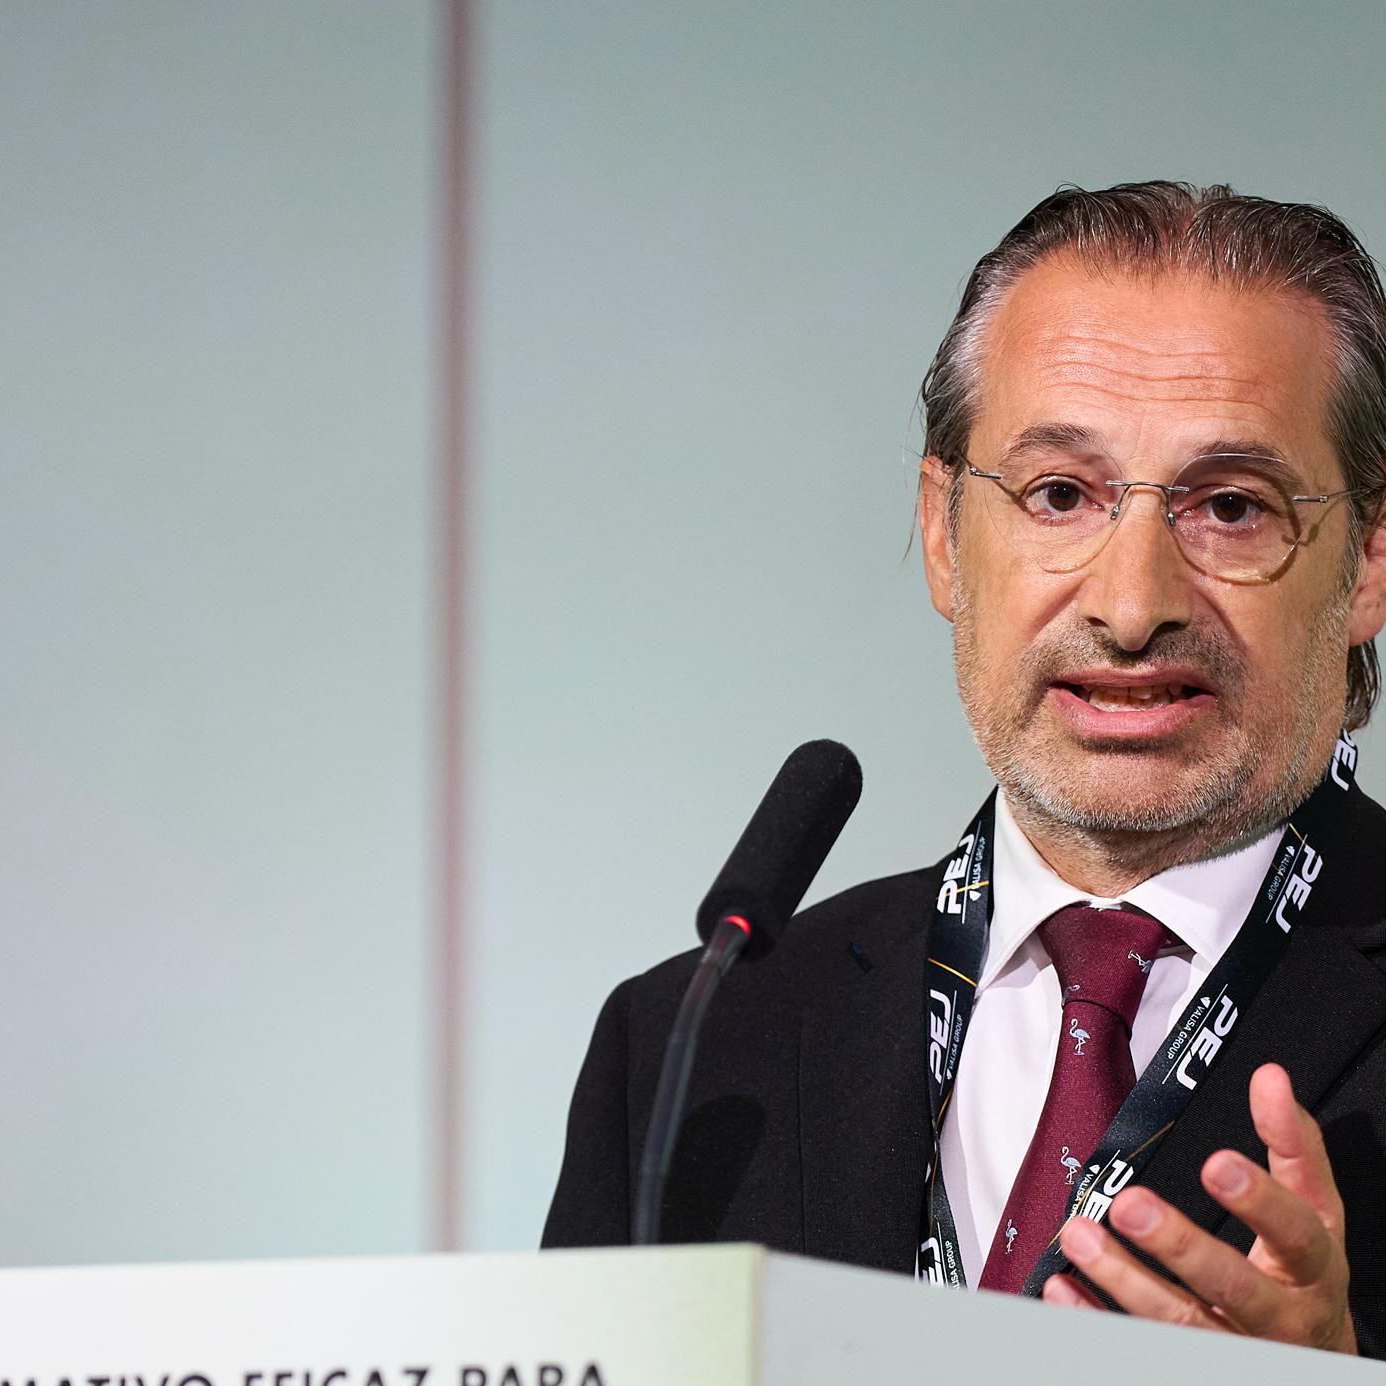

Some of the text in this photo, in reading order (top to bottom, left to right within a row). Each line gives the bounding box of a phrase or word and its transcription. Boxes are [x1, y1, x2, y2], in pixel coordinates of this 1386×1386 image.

[936, 833, 974, 914] PEJ
[1266, 875, 1282, 901] GROUP
[1275, 843, 1323, 933] PEJ
[929, 988, 951, 1085] PEJ
[954, 1014, 964, 1043] GROUP
[1166, 1005, 1206, 1060] VALISA GROUP
[1176, 995, 1239, 1091] PEJ
[1074, 1173, 1094, 1202] VALISA
[1082, 1159, 1134, 1225] PE
[921, 1237, 944, 1289] EJ
[945, 1240, 956, 1268] GROUP
